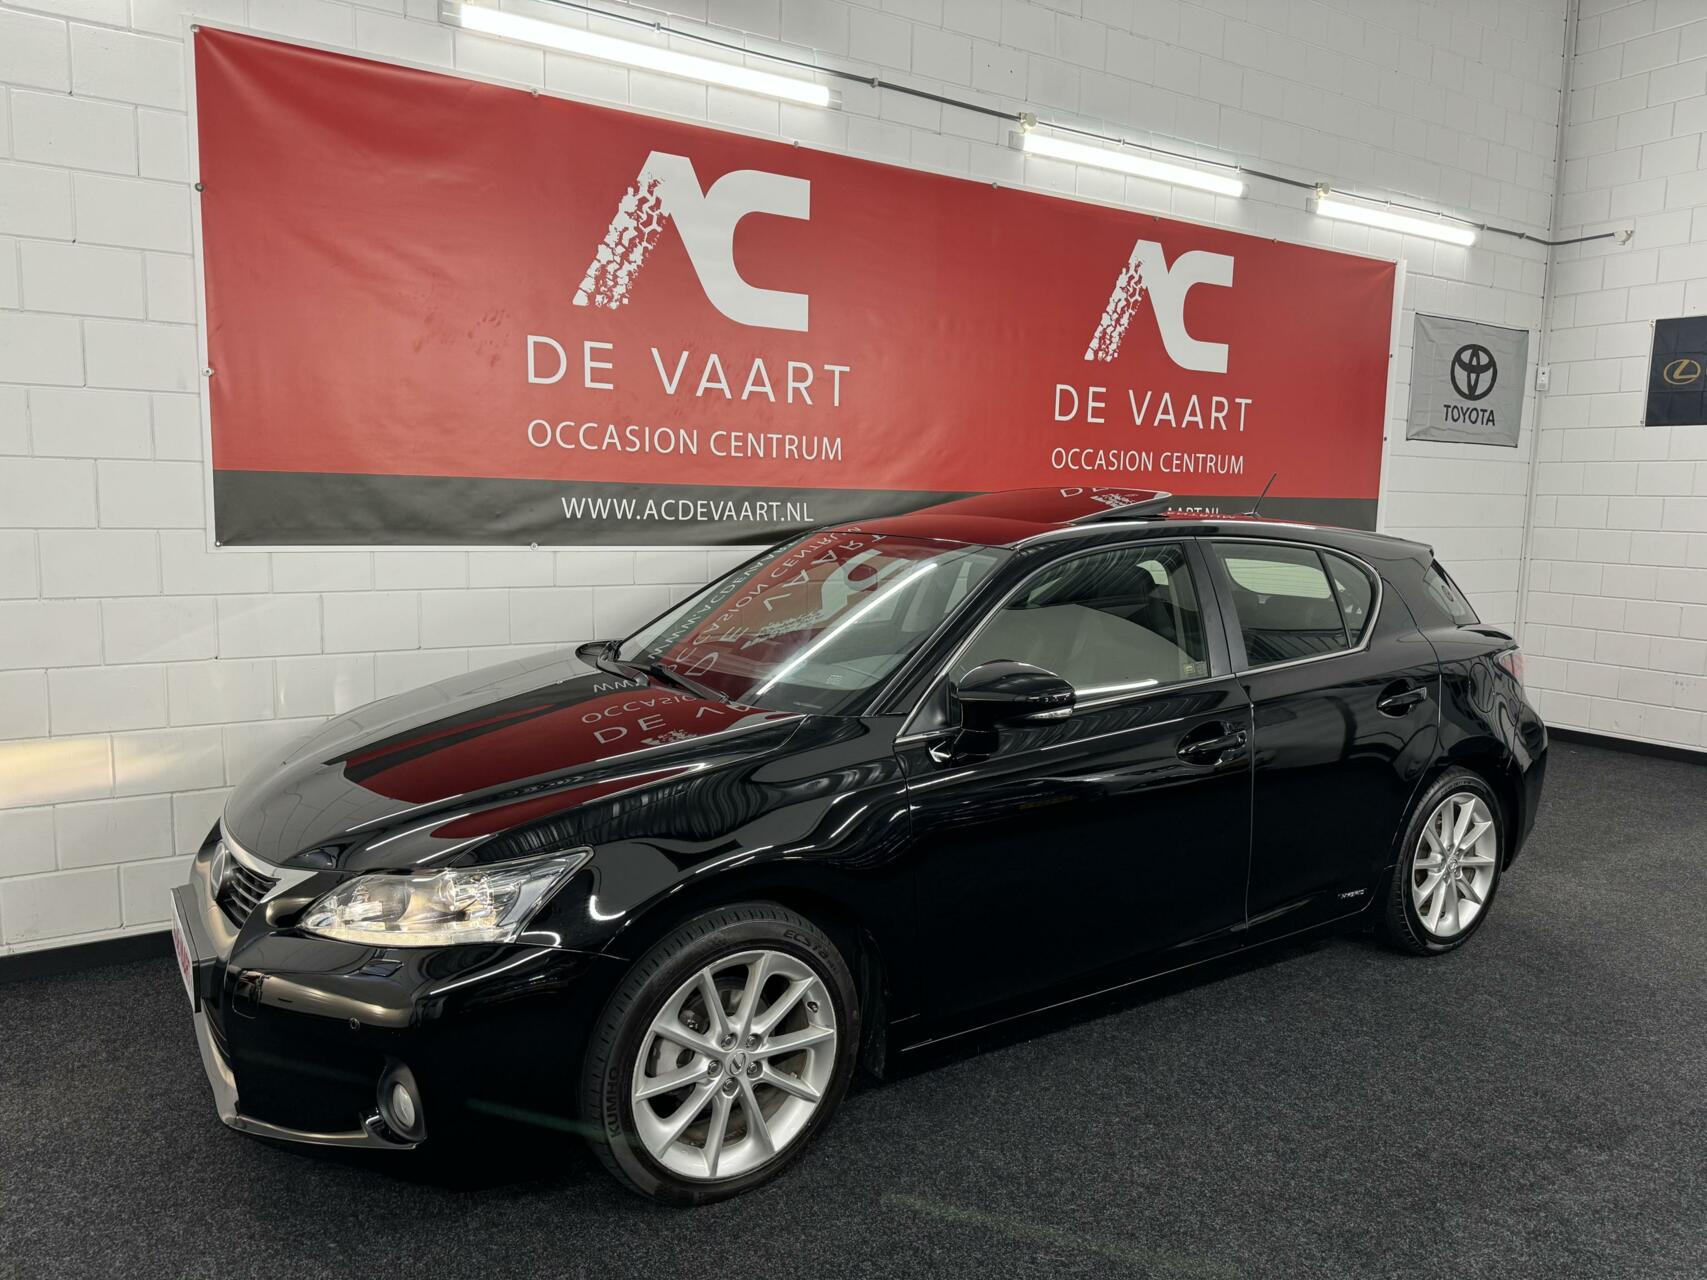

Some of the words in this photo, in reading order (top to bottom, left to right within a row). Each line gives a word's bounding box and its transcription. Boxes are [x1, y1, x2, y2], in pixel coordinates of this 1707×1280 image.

[573, 151, 810, 332] AC
[1084, 239, 1234, 373] AC
[527, 335, 613, 390] DE
[651, 347, 850, 406] VAART
[1054, 384, 1106, 423] DE
[1128, 389, 1252, 431] VAART
[1443, 404, 1496, 427] TOYOTA
[527, 419, 697, 455] OCCASION
[709, 431, 842, 461] CENTRUM
[1052, 447, 1152, 471] OCCASION
[1159, 452, 1243, 474] CENTRUM
[561, 497, 813, 522] WWW.ACDEVAART.NL
[605, 1066, 622, 1139] KUMHO
